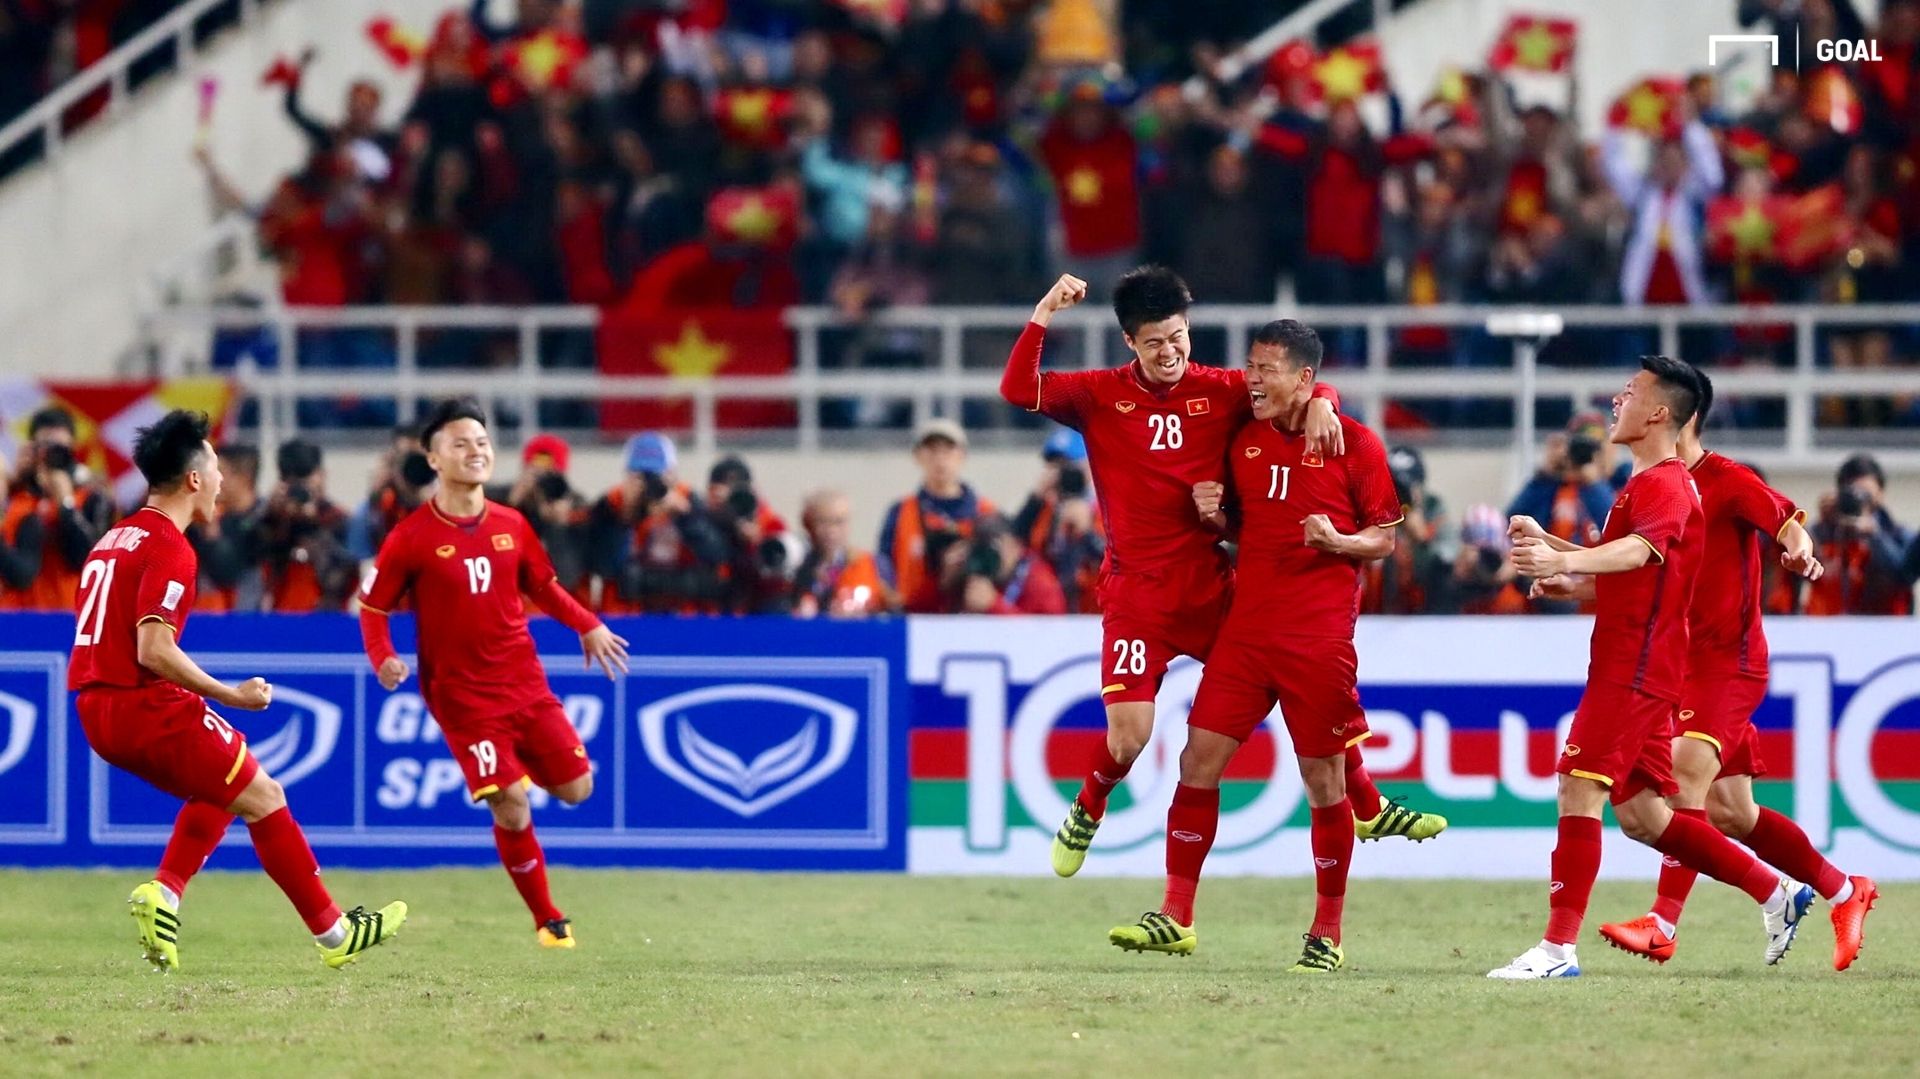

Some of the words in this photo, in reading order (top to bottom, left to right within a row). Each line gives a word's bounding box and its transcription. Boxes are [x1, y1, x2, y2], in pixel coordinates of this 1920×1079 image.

[1147, 413, 1184, 451] 28
[1267, 464, 1291, 500] 11
[463, 555, 492, 595] 19
[74, 558, 117, 647] 21
[1112, 638, 1147, 675] 28
[468, 739, 498, 778] 19
